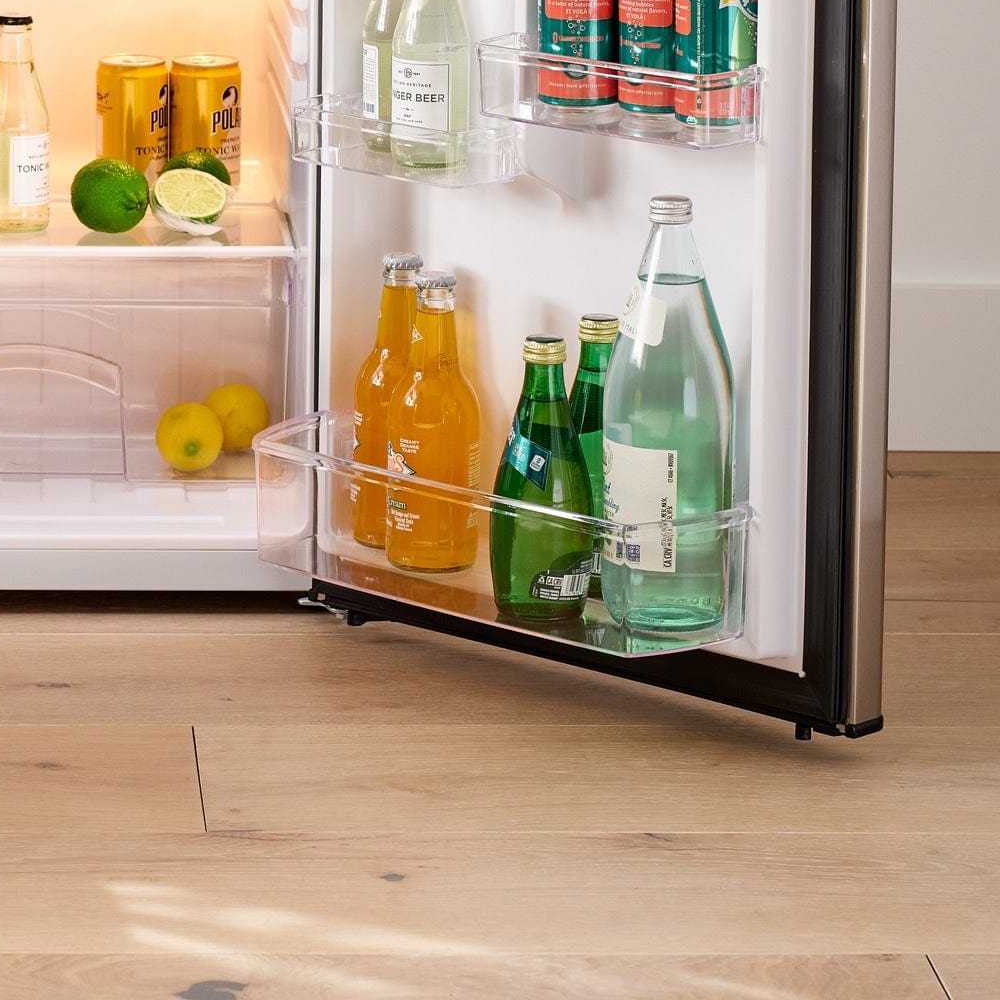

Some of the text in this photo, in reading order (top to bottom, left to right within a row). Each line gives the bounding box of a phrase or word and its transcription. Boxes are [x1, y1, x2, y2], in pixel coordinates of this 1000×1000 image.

[415, 93, 445, 103] BEER
[16, 163, 44, 173] TONIC
[663, 547, 673, 559] CRV
[663, 559, 673, 568] CA
